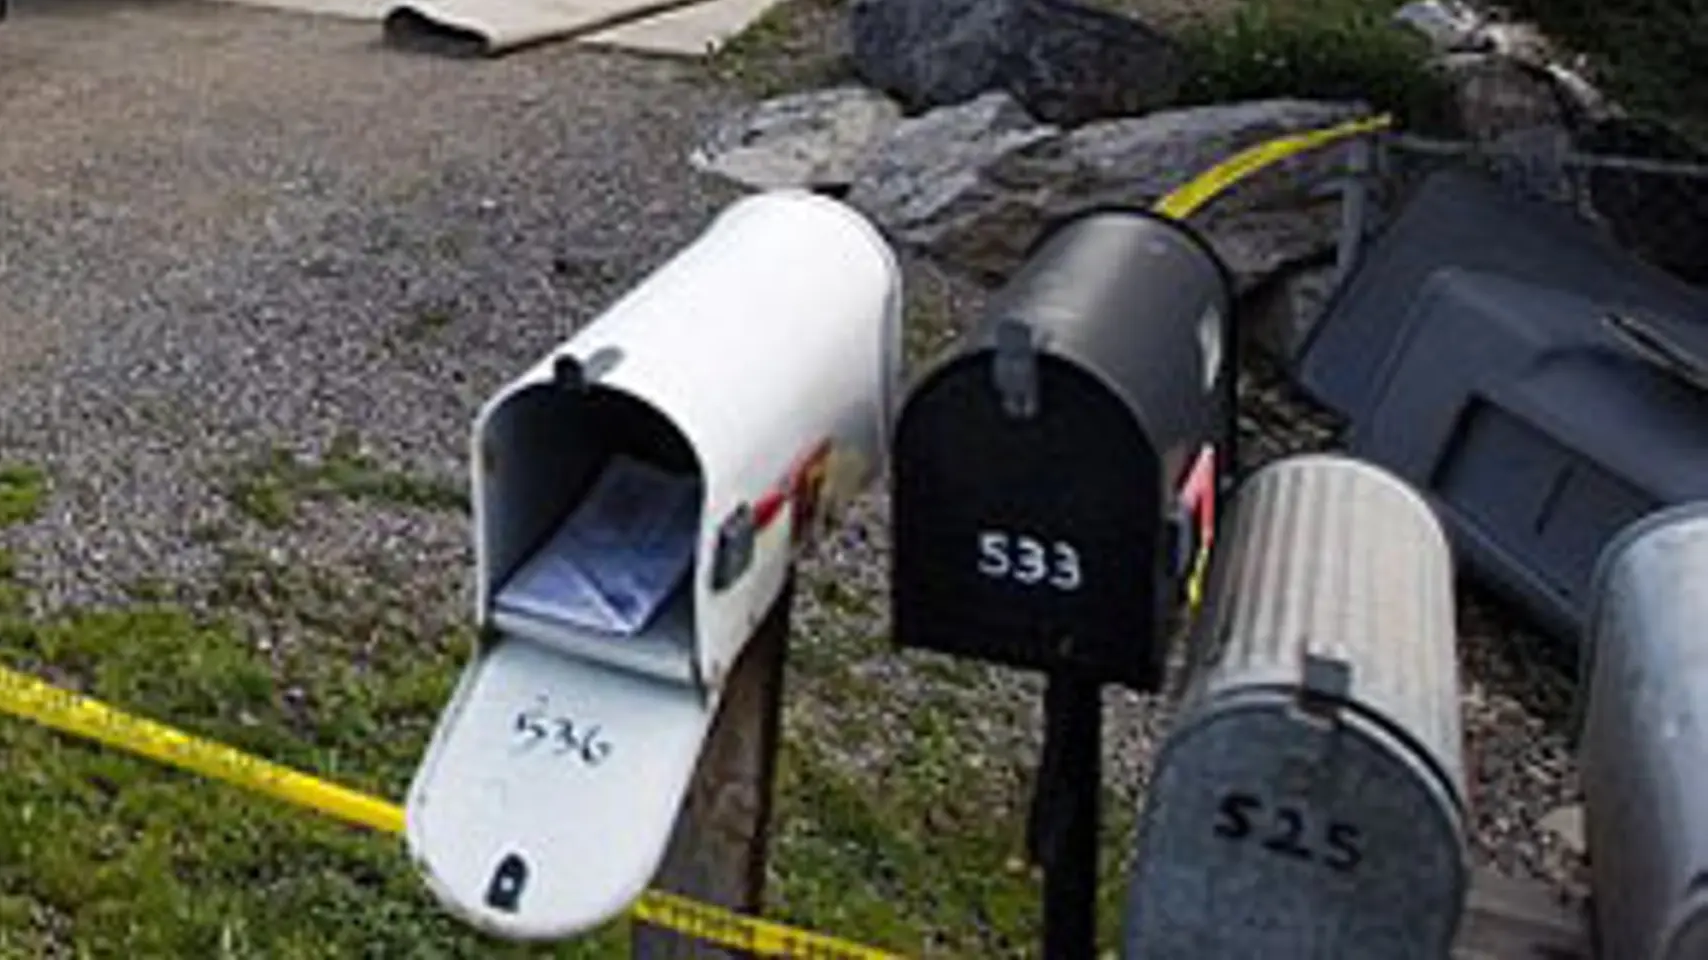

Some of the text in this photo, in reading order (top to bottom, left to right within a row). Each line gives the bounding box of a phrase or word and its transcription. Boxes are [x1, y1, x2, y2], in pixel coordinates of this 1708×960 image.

[978, 532, 1082, 590] 533
[510, 710, 614, 768] 536
[1213, 794, 1362, 871] 525
